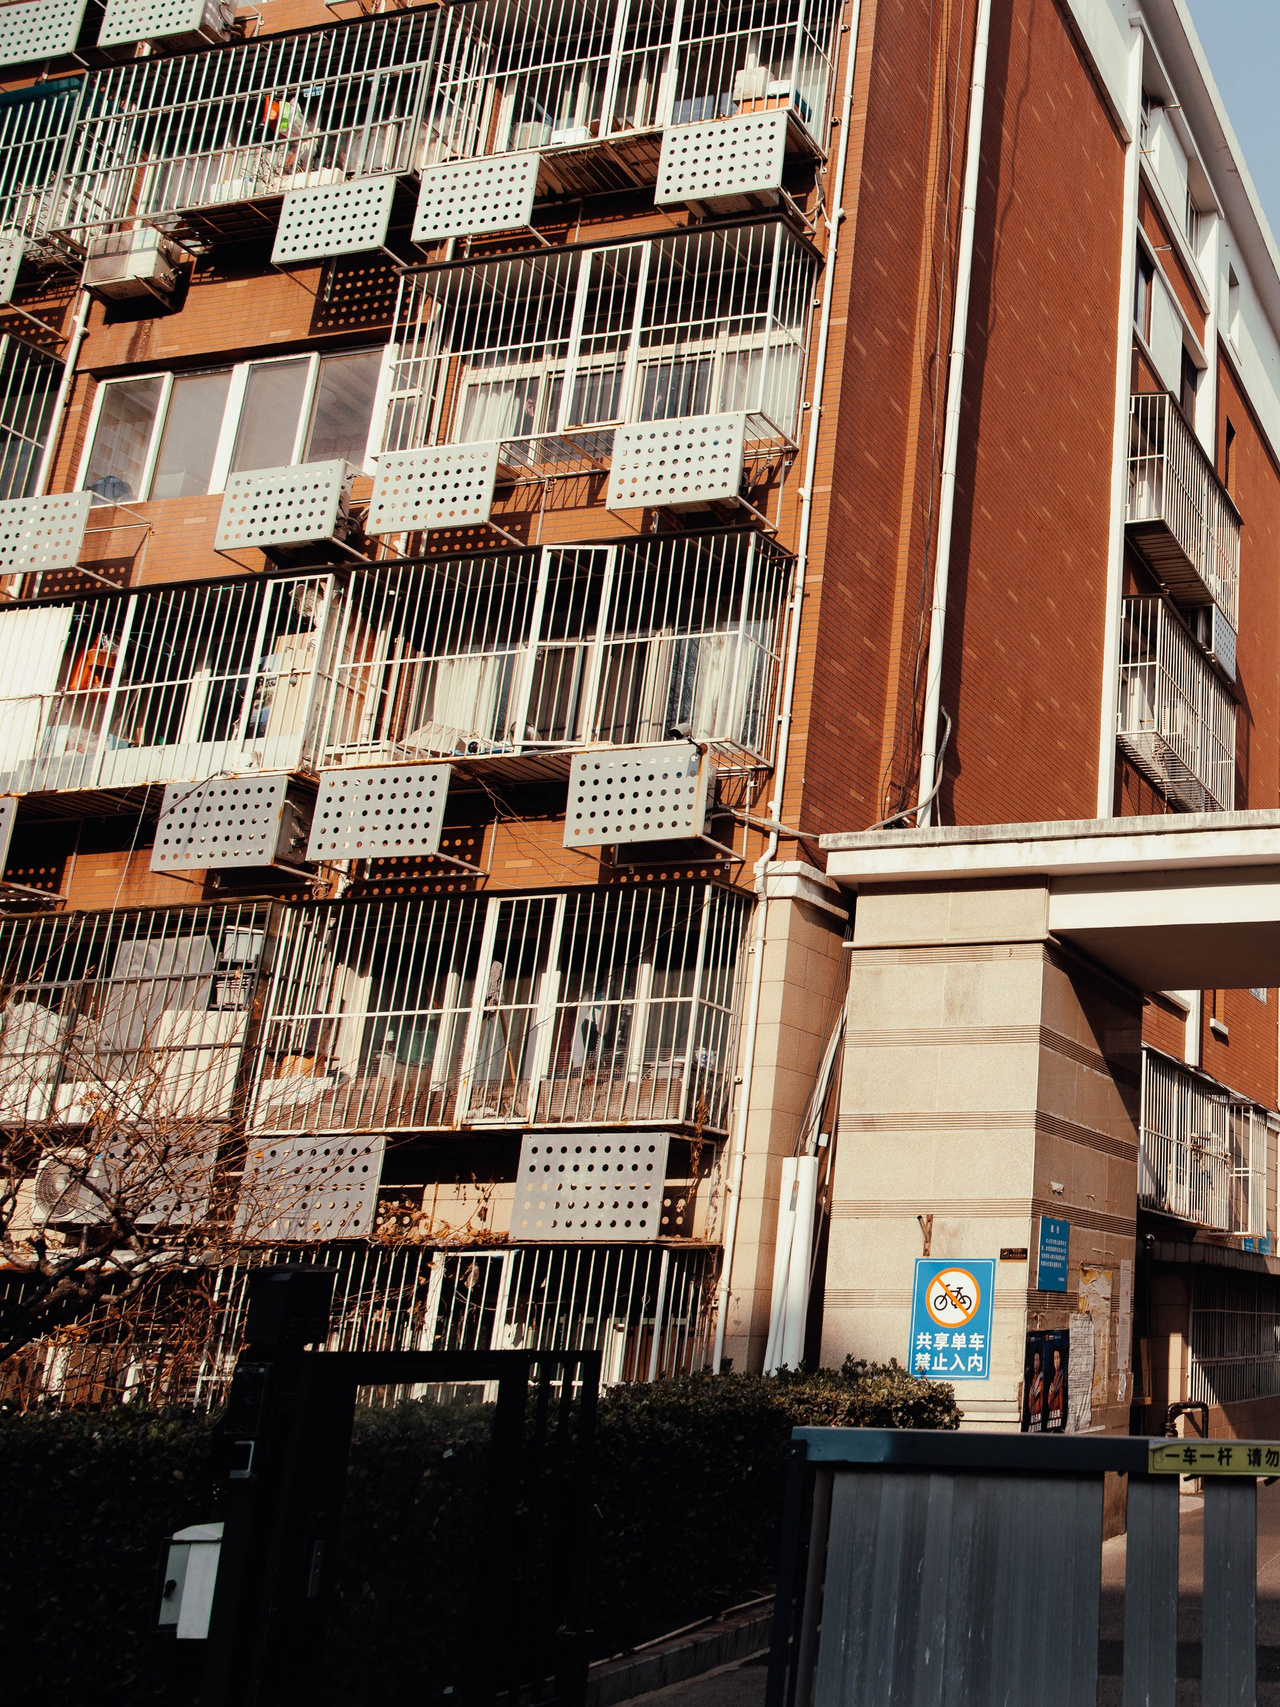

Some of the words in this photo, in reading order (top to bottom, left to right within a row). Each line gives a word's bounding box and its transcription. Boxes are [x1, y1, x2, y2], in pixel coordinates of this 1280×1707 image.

[916, 1332, 985, 1351] 共享单车
[914, 1353, 984, 1373] 禁止入内
[1165, 1447, 1234, 1467] 一车一杆
